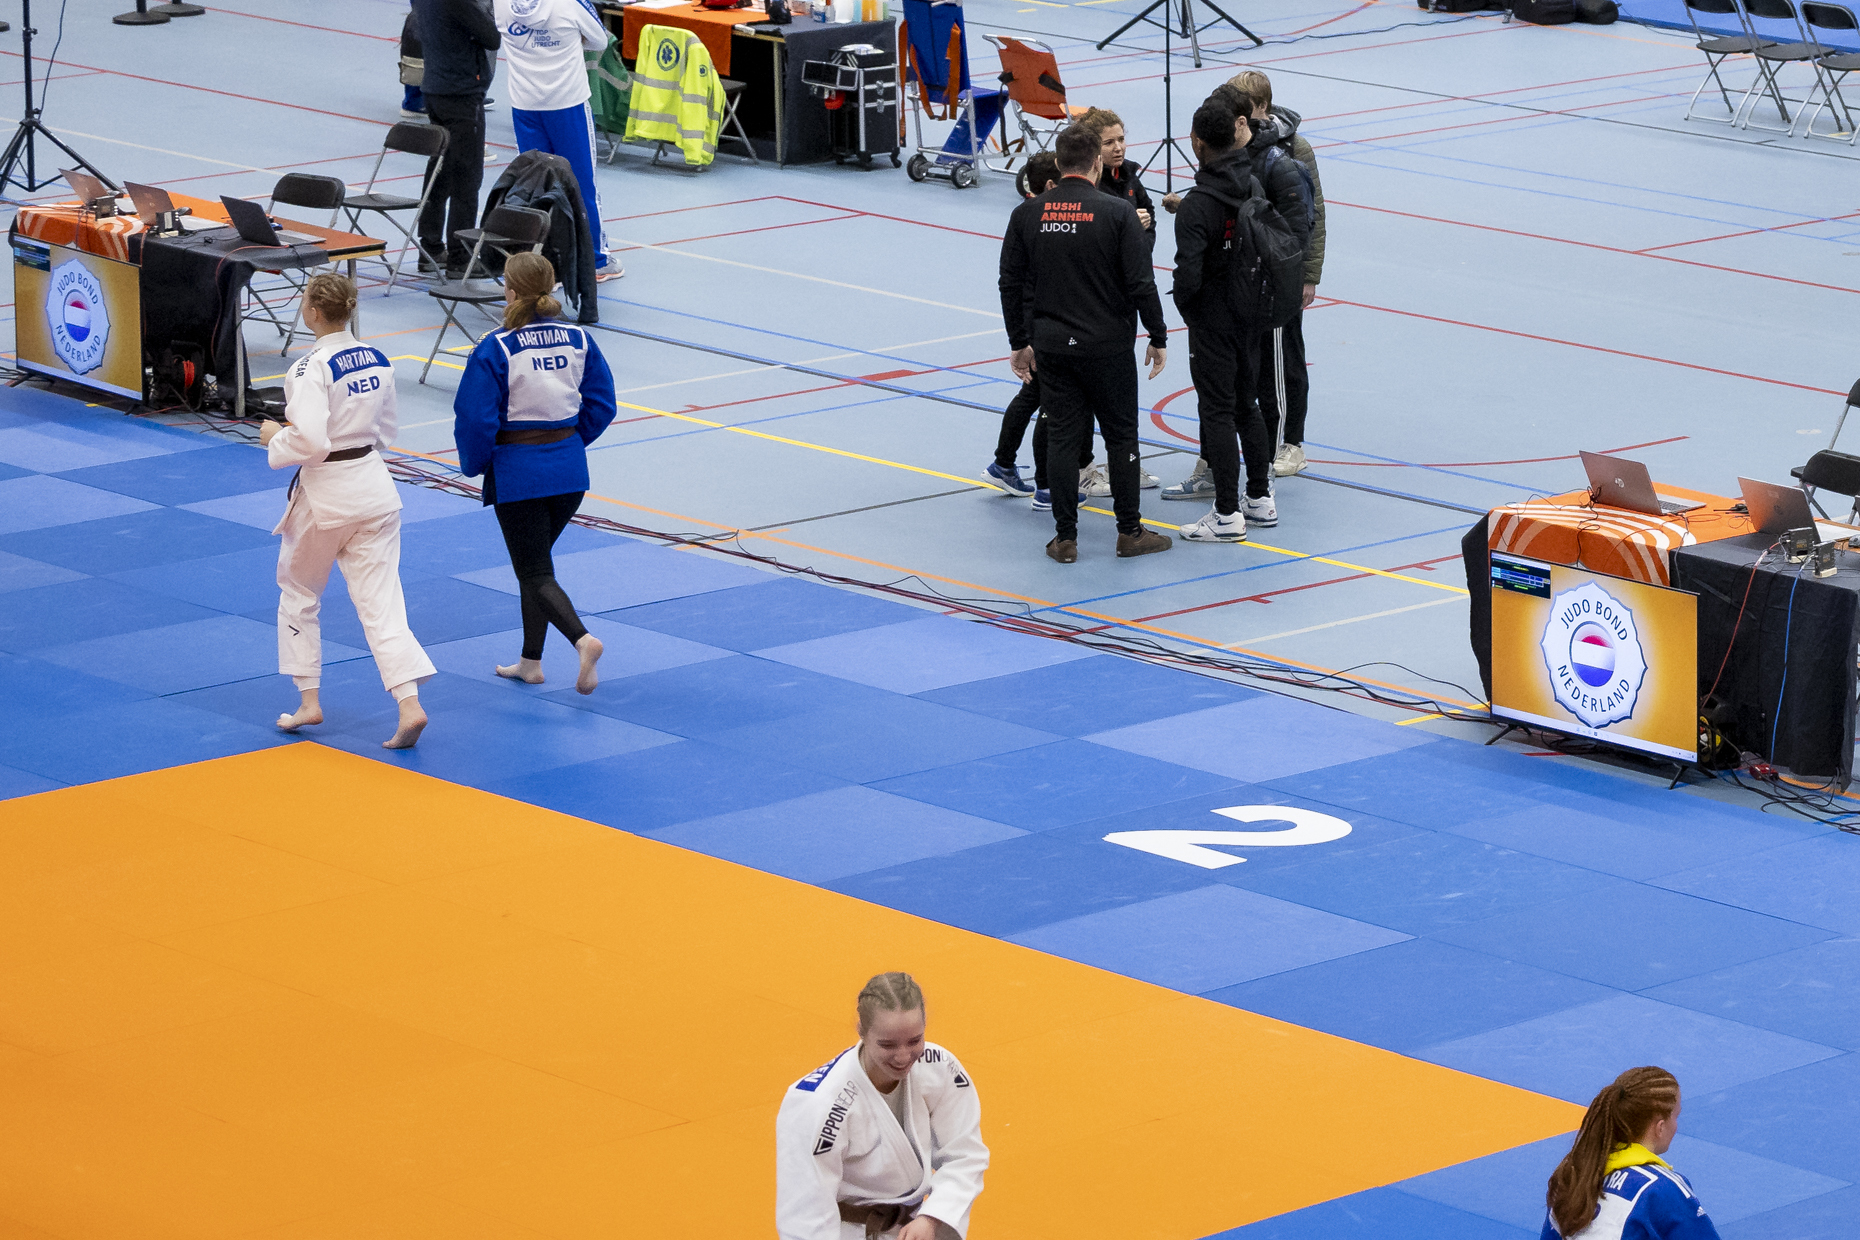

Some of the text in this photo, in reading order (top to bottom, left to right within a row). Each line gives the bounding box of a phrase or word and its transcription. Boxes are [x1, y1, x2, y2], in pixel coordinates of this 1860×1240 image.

[531, 40, 561, 49] UTRECHT
[1040, 212, 1094, 222] ARNHEM
[1040, 222, 1071, 233] JUDO
[57, 271, 98, 305] JUDO BOND
[56, 324, 101, 363] NEDERLAND
[516, 328, 570, 348] HARTMAN
[336, 350, 379, 373] HARTMAN
[531, 355, 568, 371] NED
[347, 375, 380, 397] NED
[1561, 599, 1628, 641] JUDO BOND
[1557, 664, 1630, 713] NEDERLAND
[1101, 805, 1353, 870] 2
